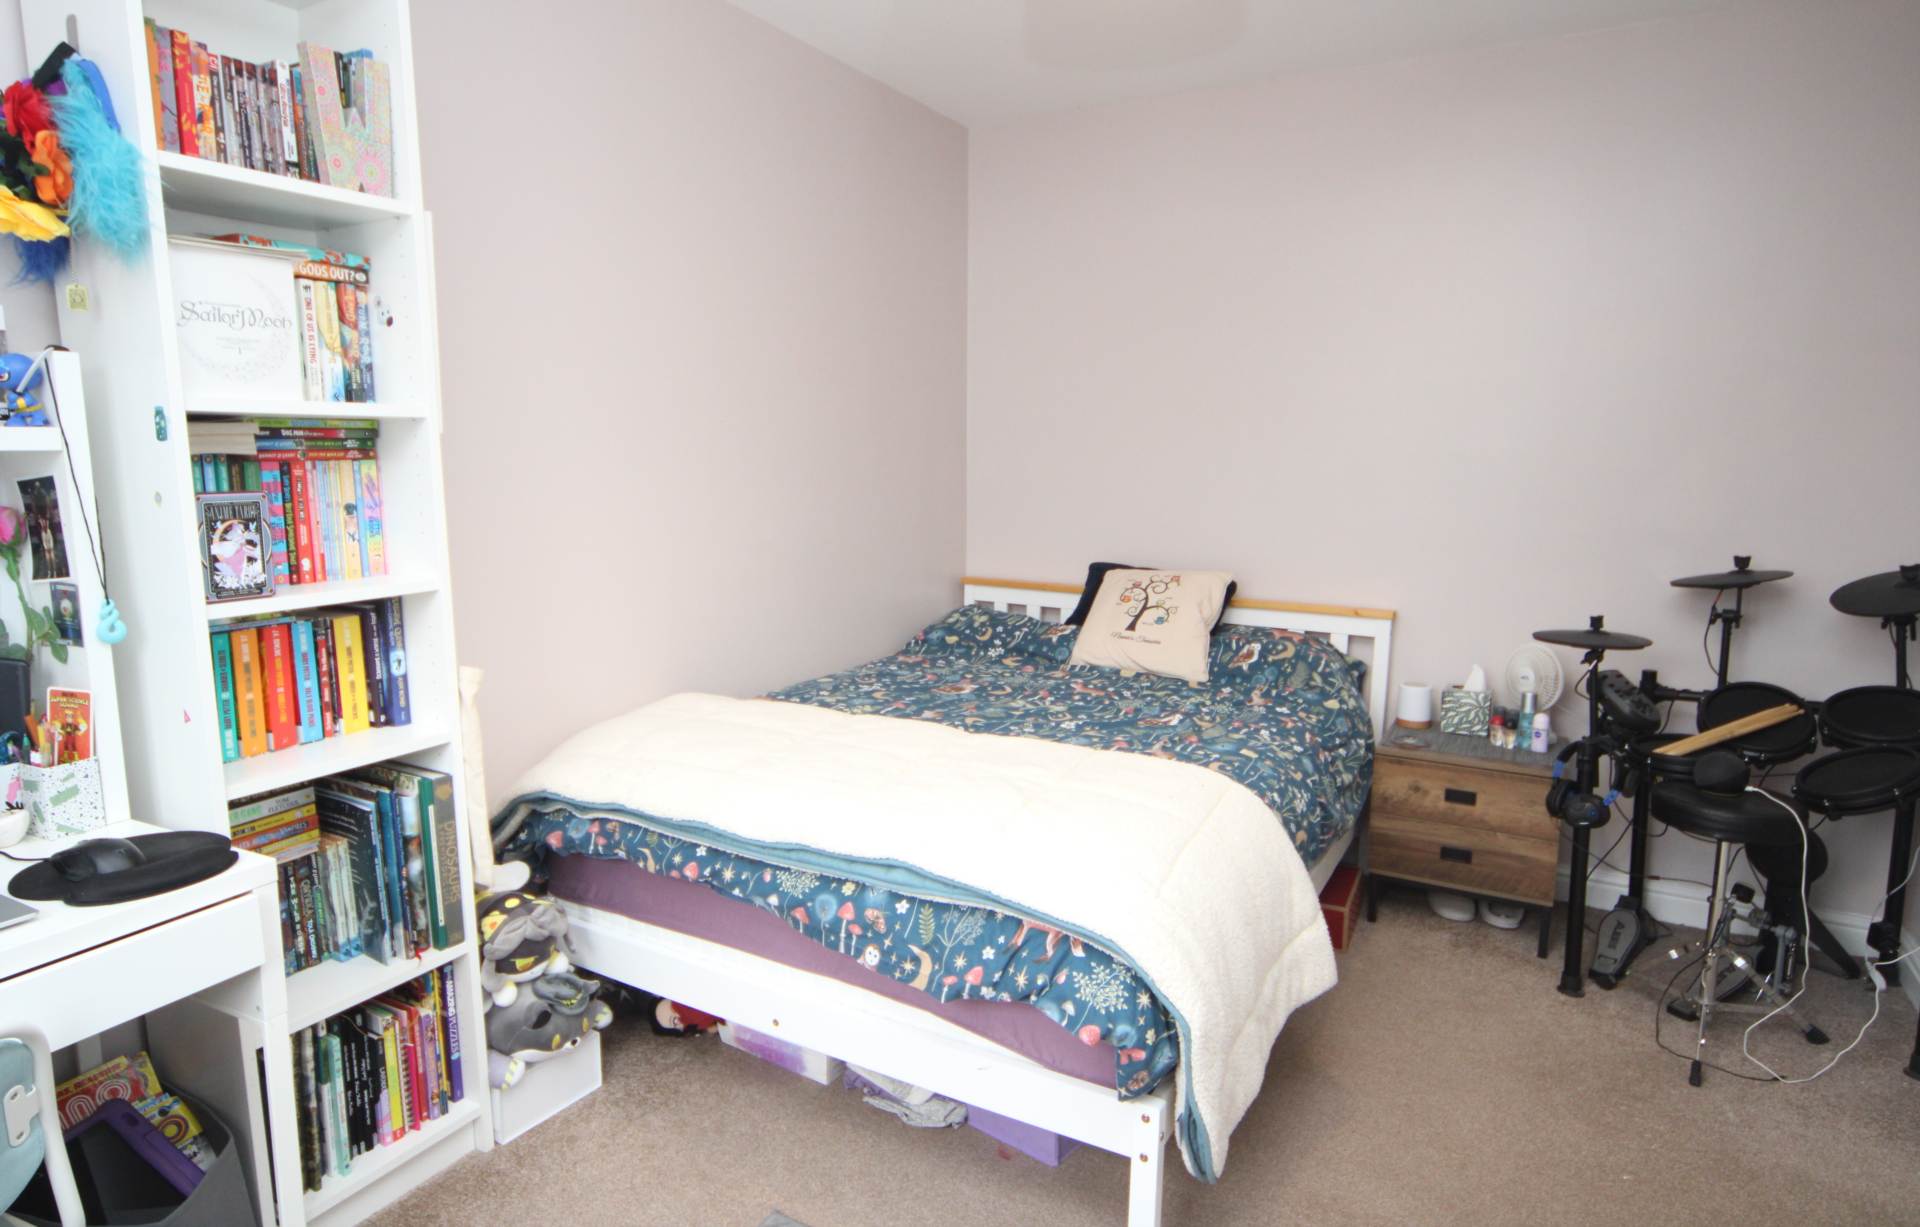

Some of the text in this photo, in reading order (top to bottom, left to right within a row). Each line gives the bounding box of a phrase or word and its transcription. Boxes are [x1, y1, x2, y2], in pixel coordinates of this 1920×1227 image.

[299, 262, 355, 282] GODS OUT?
[177, 300, 292, 330] Sailor Moon
[304, 312, 314, 321] OF
[305, 321, 315, 333] US
[307, 342, 318, 364] LYING
[443, 820, 461, 903] DINOSAURS
[444, 980, 456, 1017] AMAZING
